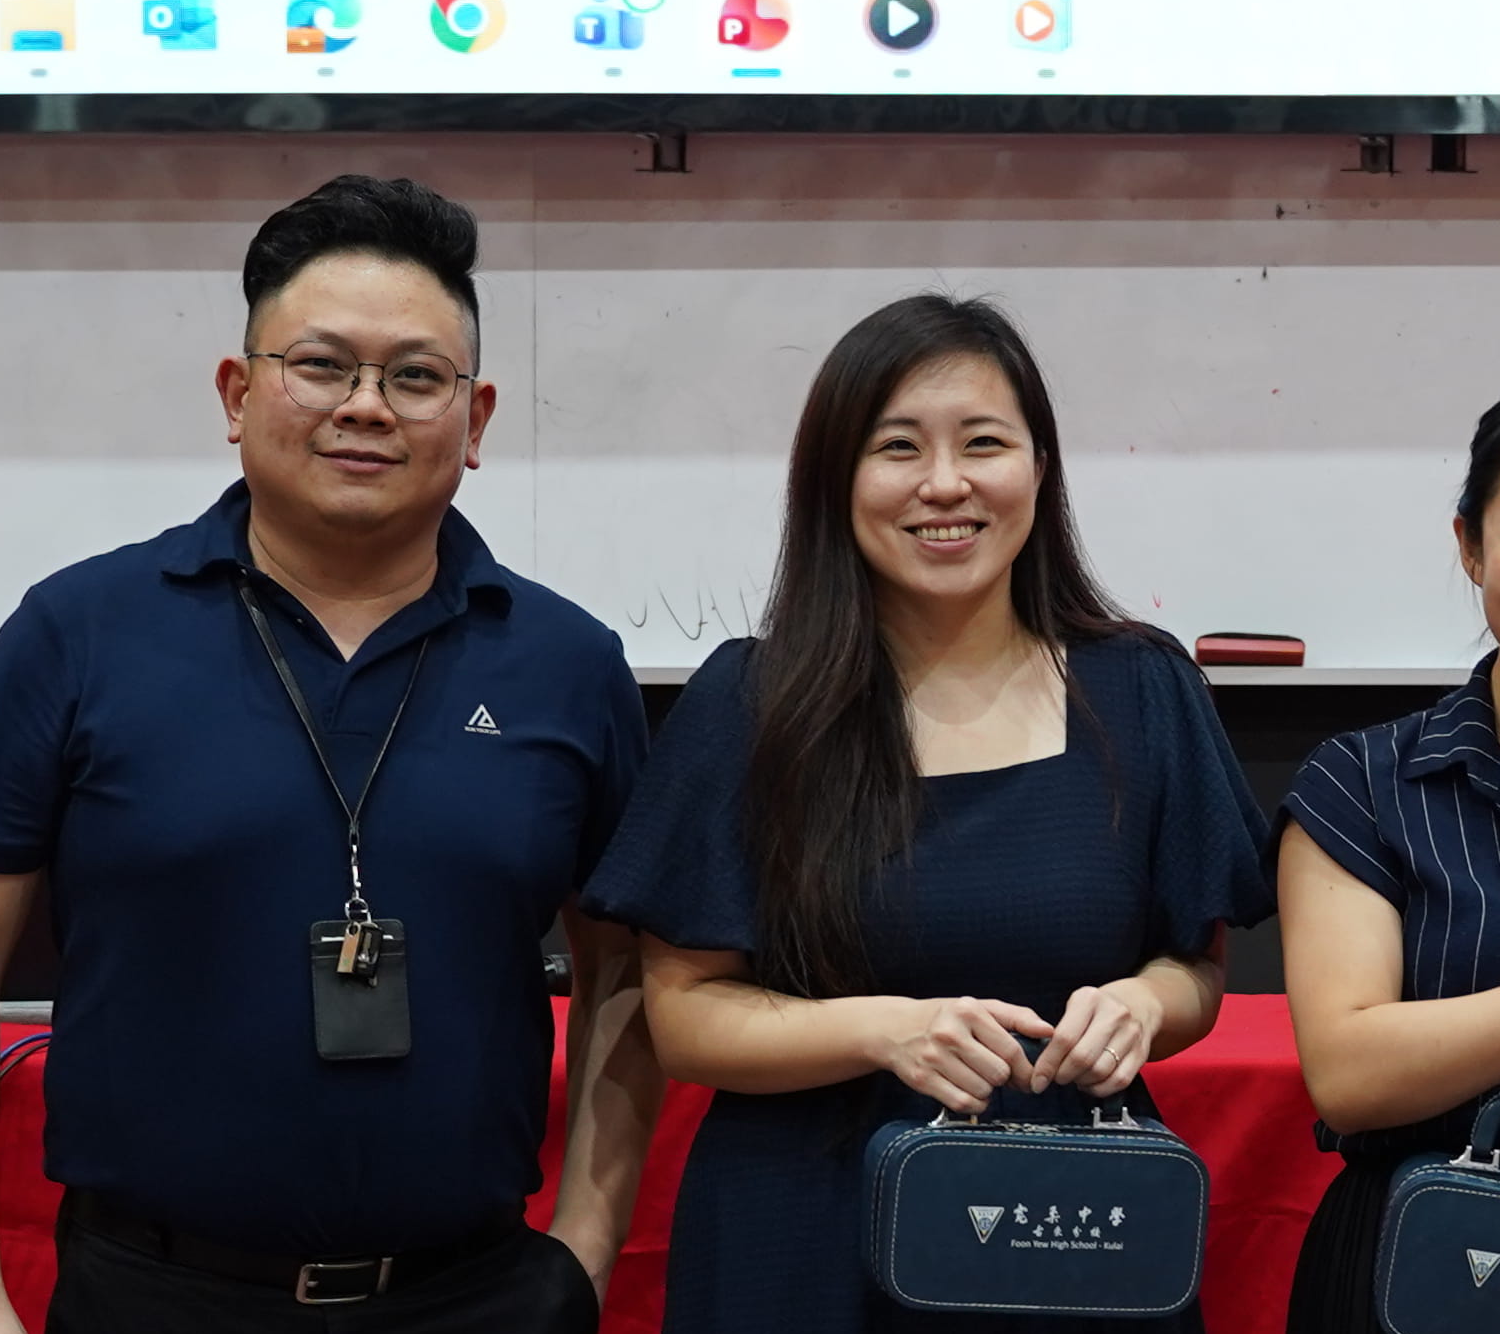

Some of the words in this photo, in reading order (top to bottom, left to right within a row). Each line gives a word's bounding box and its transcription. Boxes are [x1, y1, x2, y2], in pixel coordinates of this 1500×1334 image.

[1011, 1239, 1032, 1248] Foon
[1033, 1240, 1049, 1249] Yew
[1050, 1240, 1070, 1251] High
[1070, 1241, 1098, 1250] School
